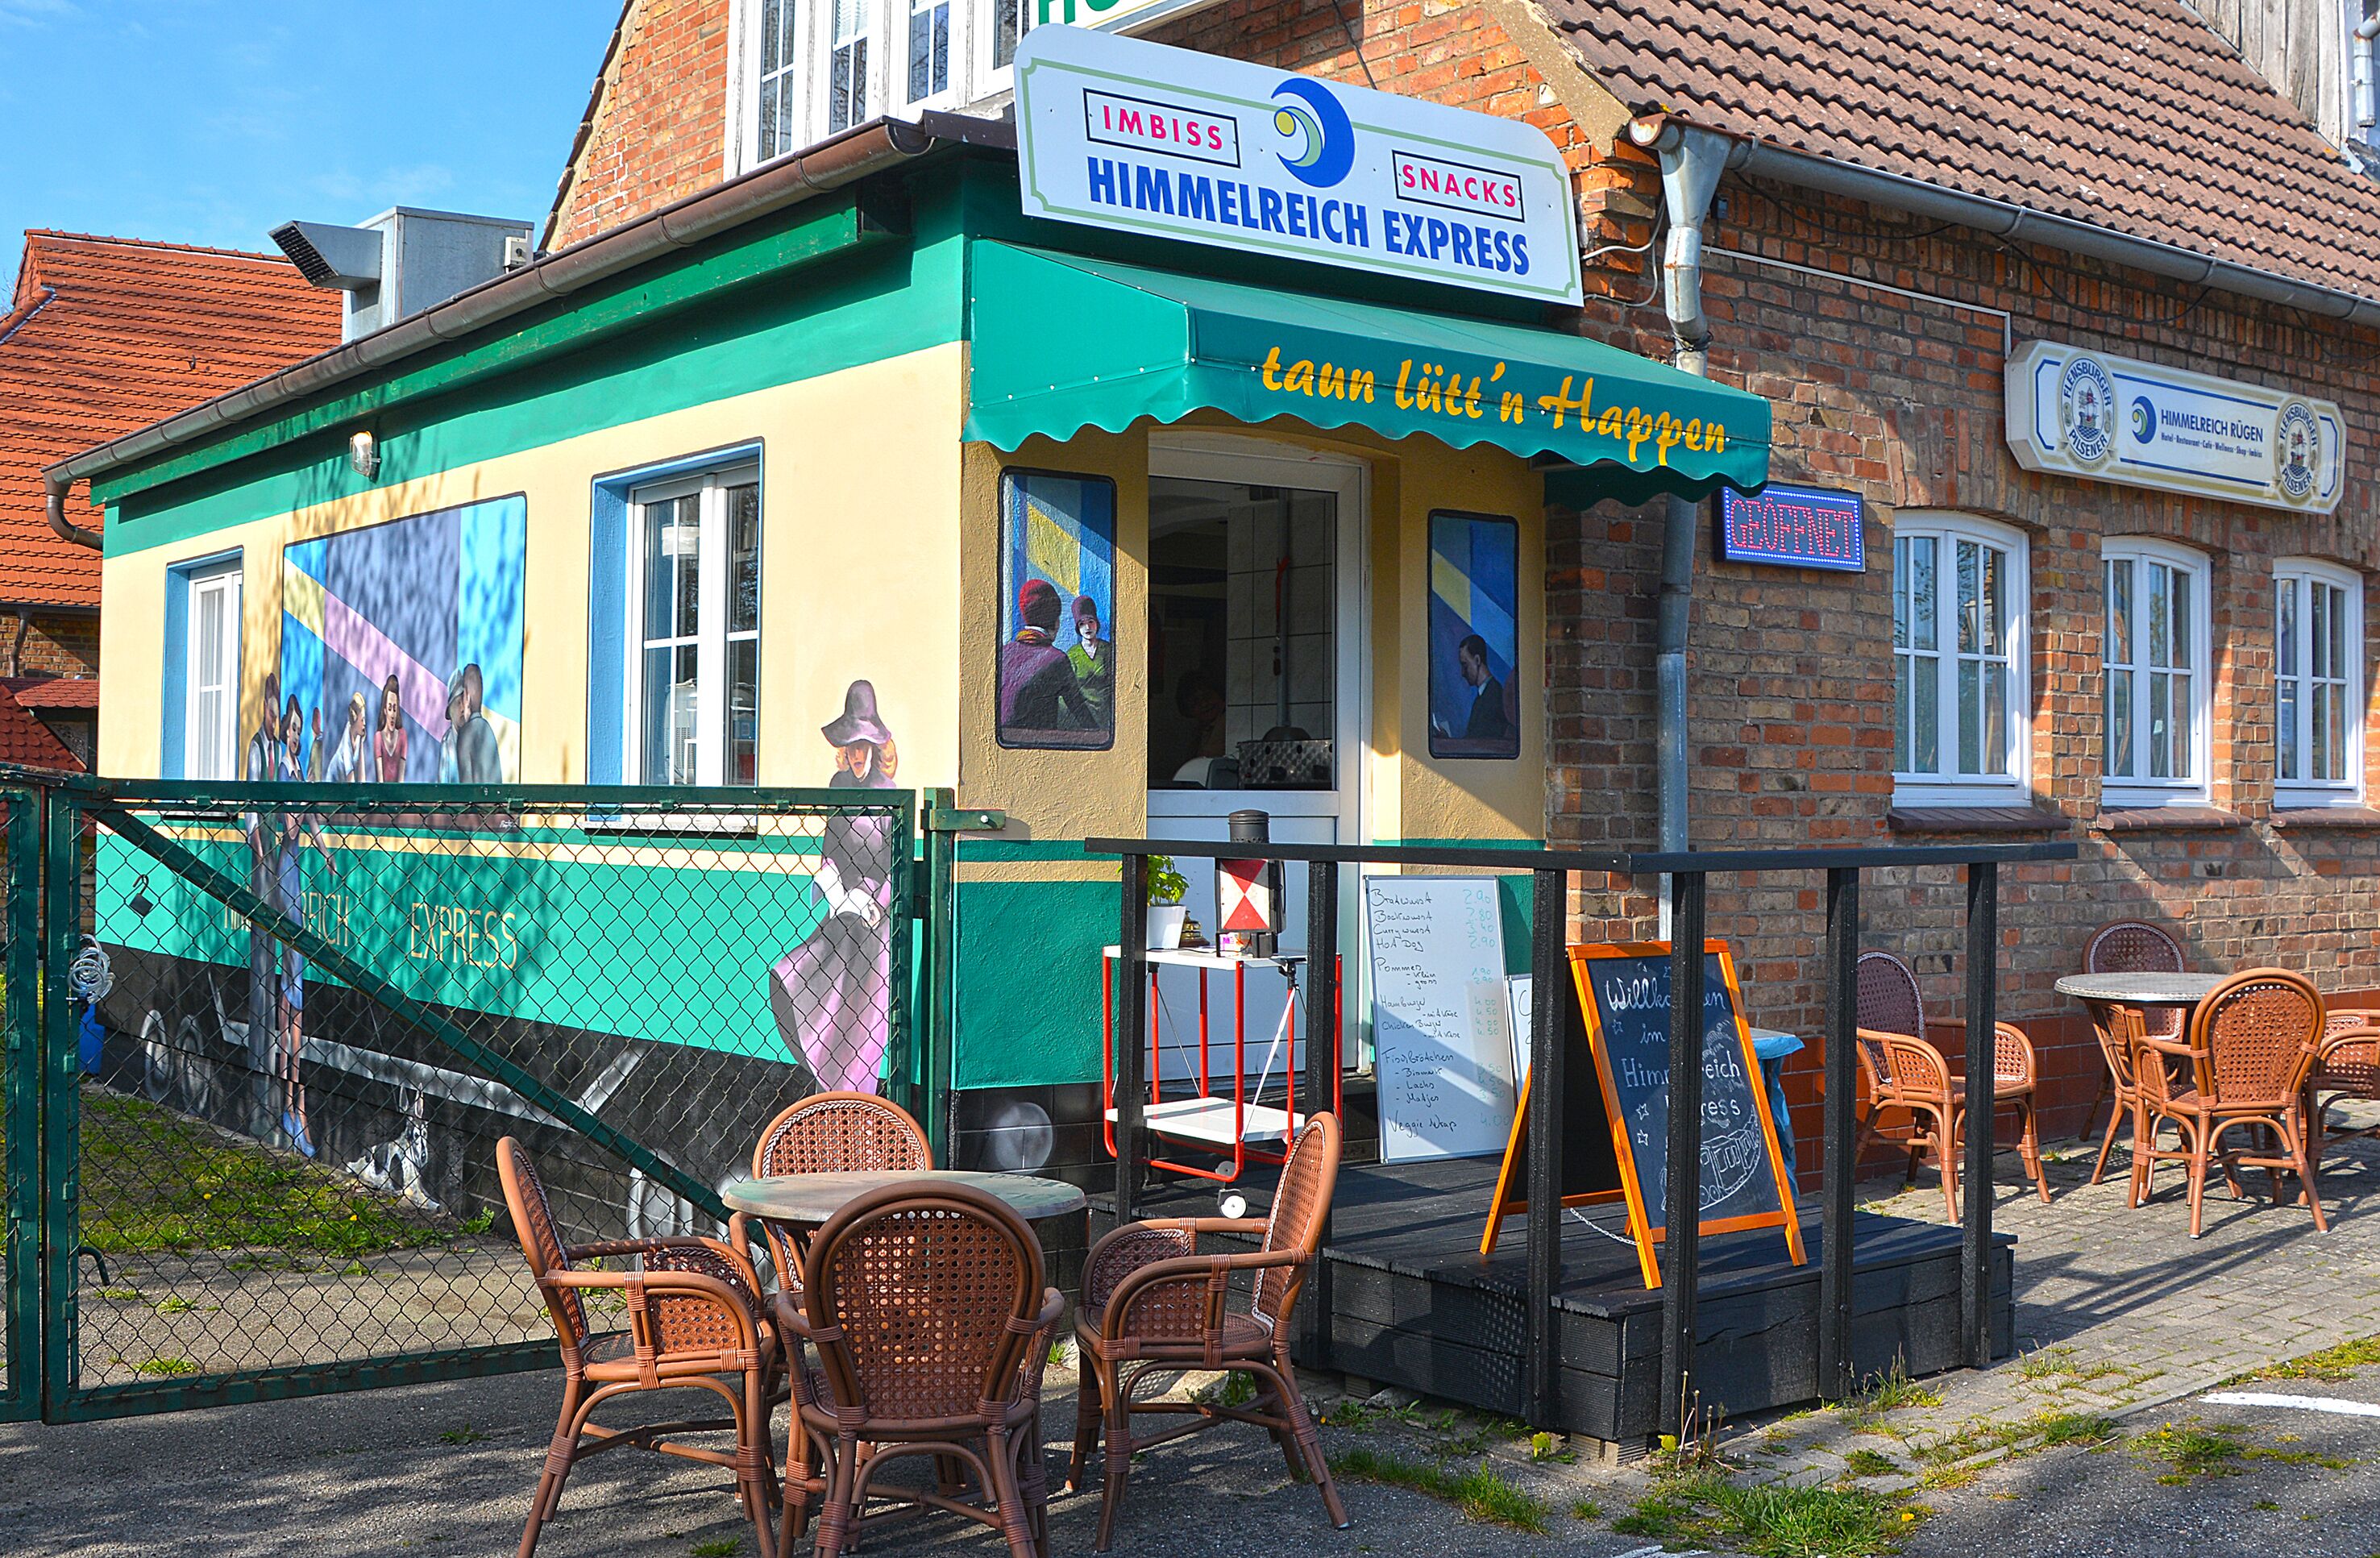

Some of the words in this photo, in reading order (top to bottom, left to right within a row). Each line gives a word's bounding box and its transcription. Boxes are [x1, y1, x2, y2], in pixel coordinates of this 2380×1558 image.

[1103, 105, 1223, 151] IMBISS
[1402, 164, 1517, 209] SNACKS
[1087, 156, 1371, 248] HIMMELREICH
[1382, 209, 1531, 276] EXPRESS
[2063, 362, 2112, 406] FLENSBURGER
[1261, 347, 1376, 403] taun
[1538, 375, 1727, 467] Happen
[2161, 409, 2228, 436] HIMMELREICH
[2230, 419, 2264, 442] RÜGEN
[2279, 405, 2318, 447] FLENSBURGER
[2068, 428, 2108, 457] PILSENER
[2282, 467, 2313, 493] PILSENER
[1730, 496, 1856, 559] GEÖFFNET
[1371, 888, 1432, 907] Bratwurst
[1374, 909, 1433, 923] Bockwurst
[410, 902, 517, 970] EXPRESS
[1373, 923, 1431, 939] Currywurst
[1377, 937, 1398, 949] Hot
[1402, 939, 1424, 953] Dog
[1374, 956, 1423, 973] Pommes
[1380, 995, 1426, 1011] Hamburger
[1381, 1020, 1415, 1031] Chicken
[1415, 1019, 1442, 1035] Burger
[1639, 1023, 1666, 1044] im
[1406, 1081, 1435, 1090] Lachs
[1406, 1092, 1439, 1108] Matjes
[1388, 1110, 1423, 1138] Veggie
[1429, 1114, 1457, 1132] Wrap
